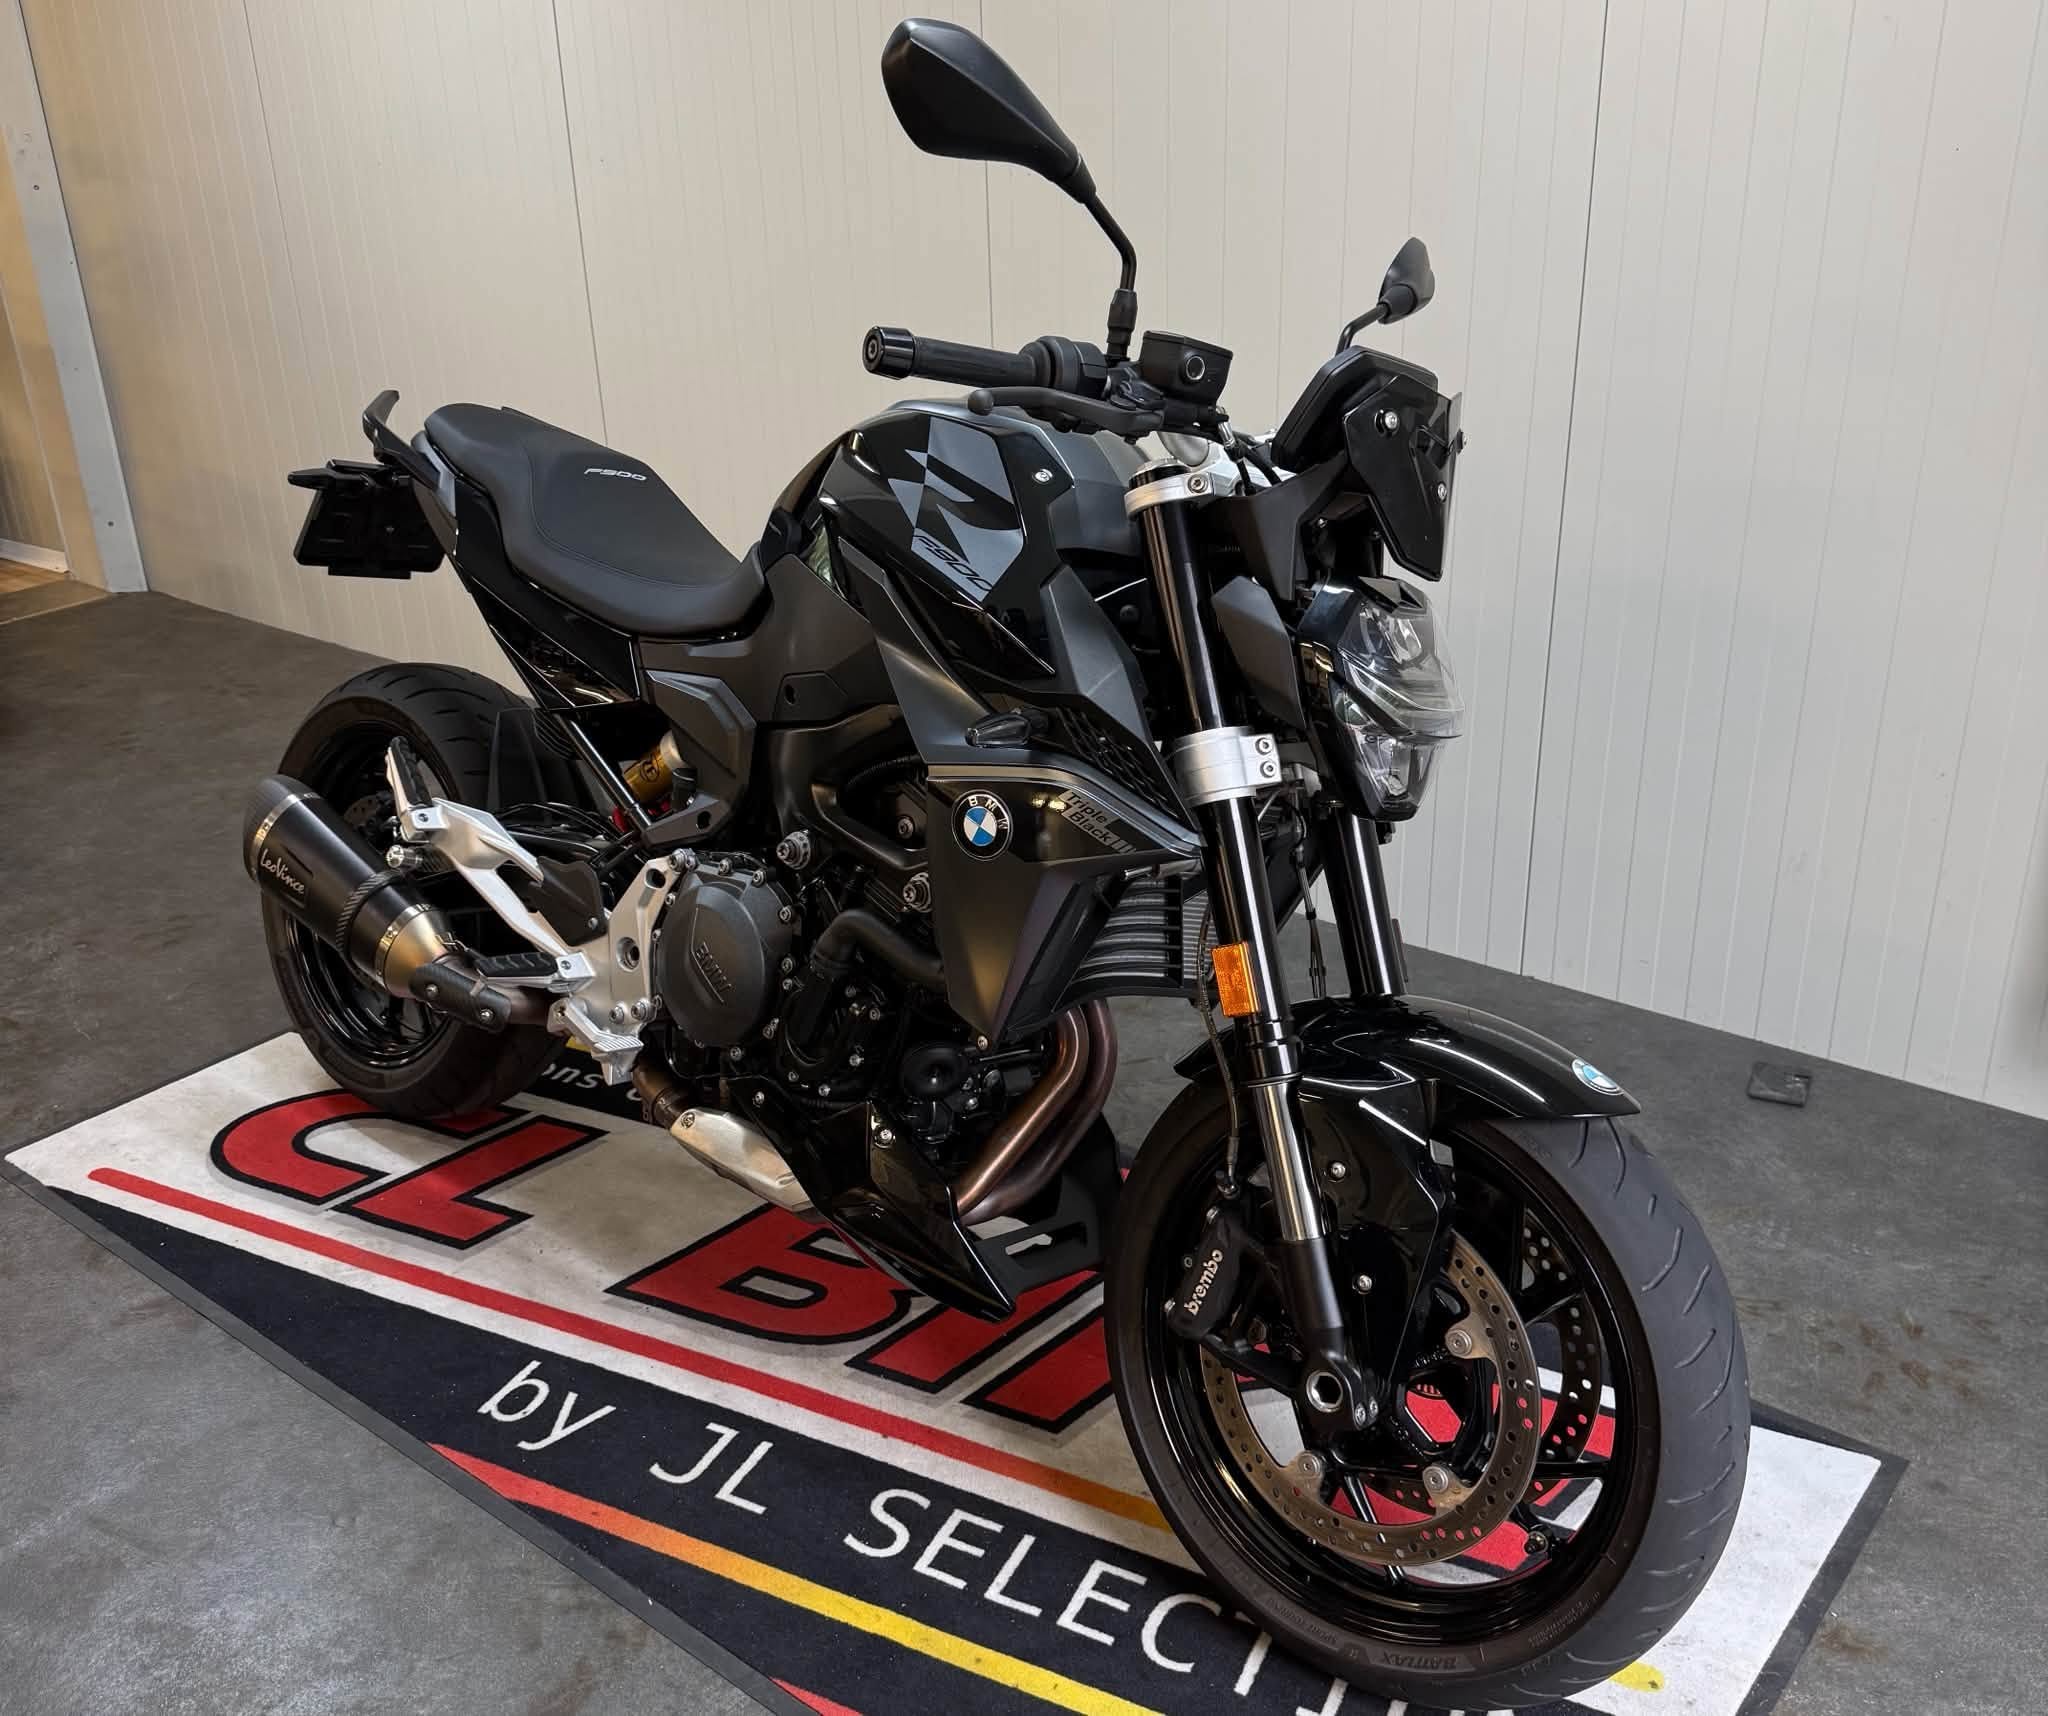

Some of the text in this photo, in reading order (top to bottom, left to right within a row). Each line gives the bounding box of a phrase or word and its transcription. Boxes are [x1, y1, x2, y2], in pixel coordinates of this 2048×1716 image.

[583, 467, 647, 481] F900
[913, 534, 993, 592] F900
[1067, 791, 1109, 825] Triple
[1067, 809, 1113, 843] Black
[260, 848, 305, 895] LeoVince
[695, 940, 732, 996] BMW
[1183, 1248, 1224, 1317] brembo
[476, 1359, 617, 1451] by
[649, 1421, 774, 1516] JL
